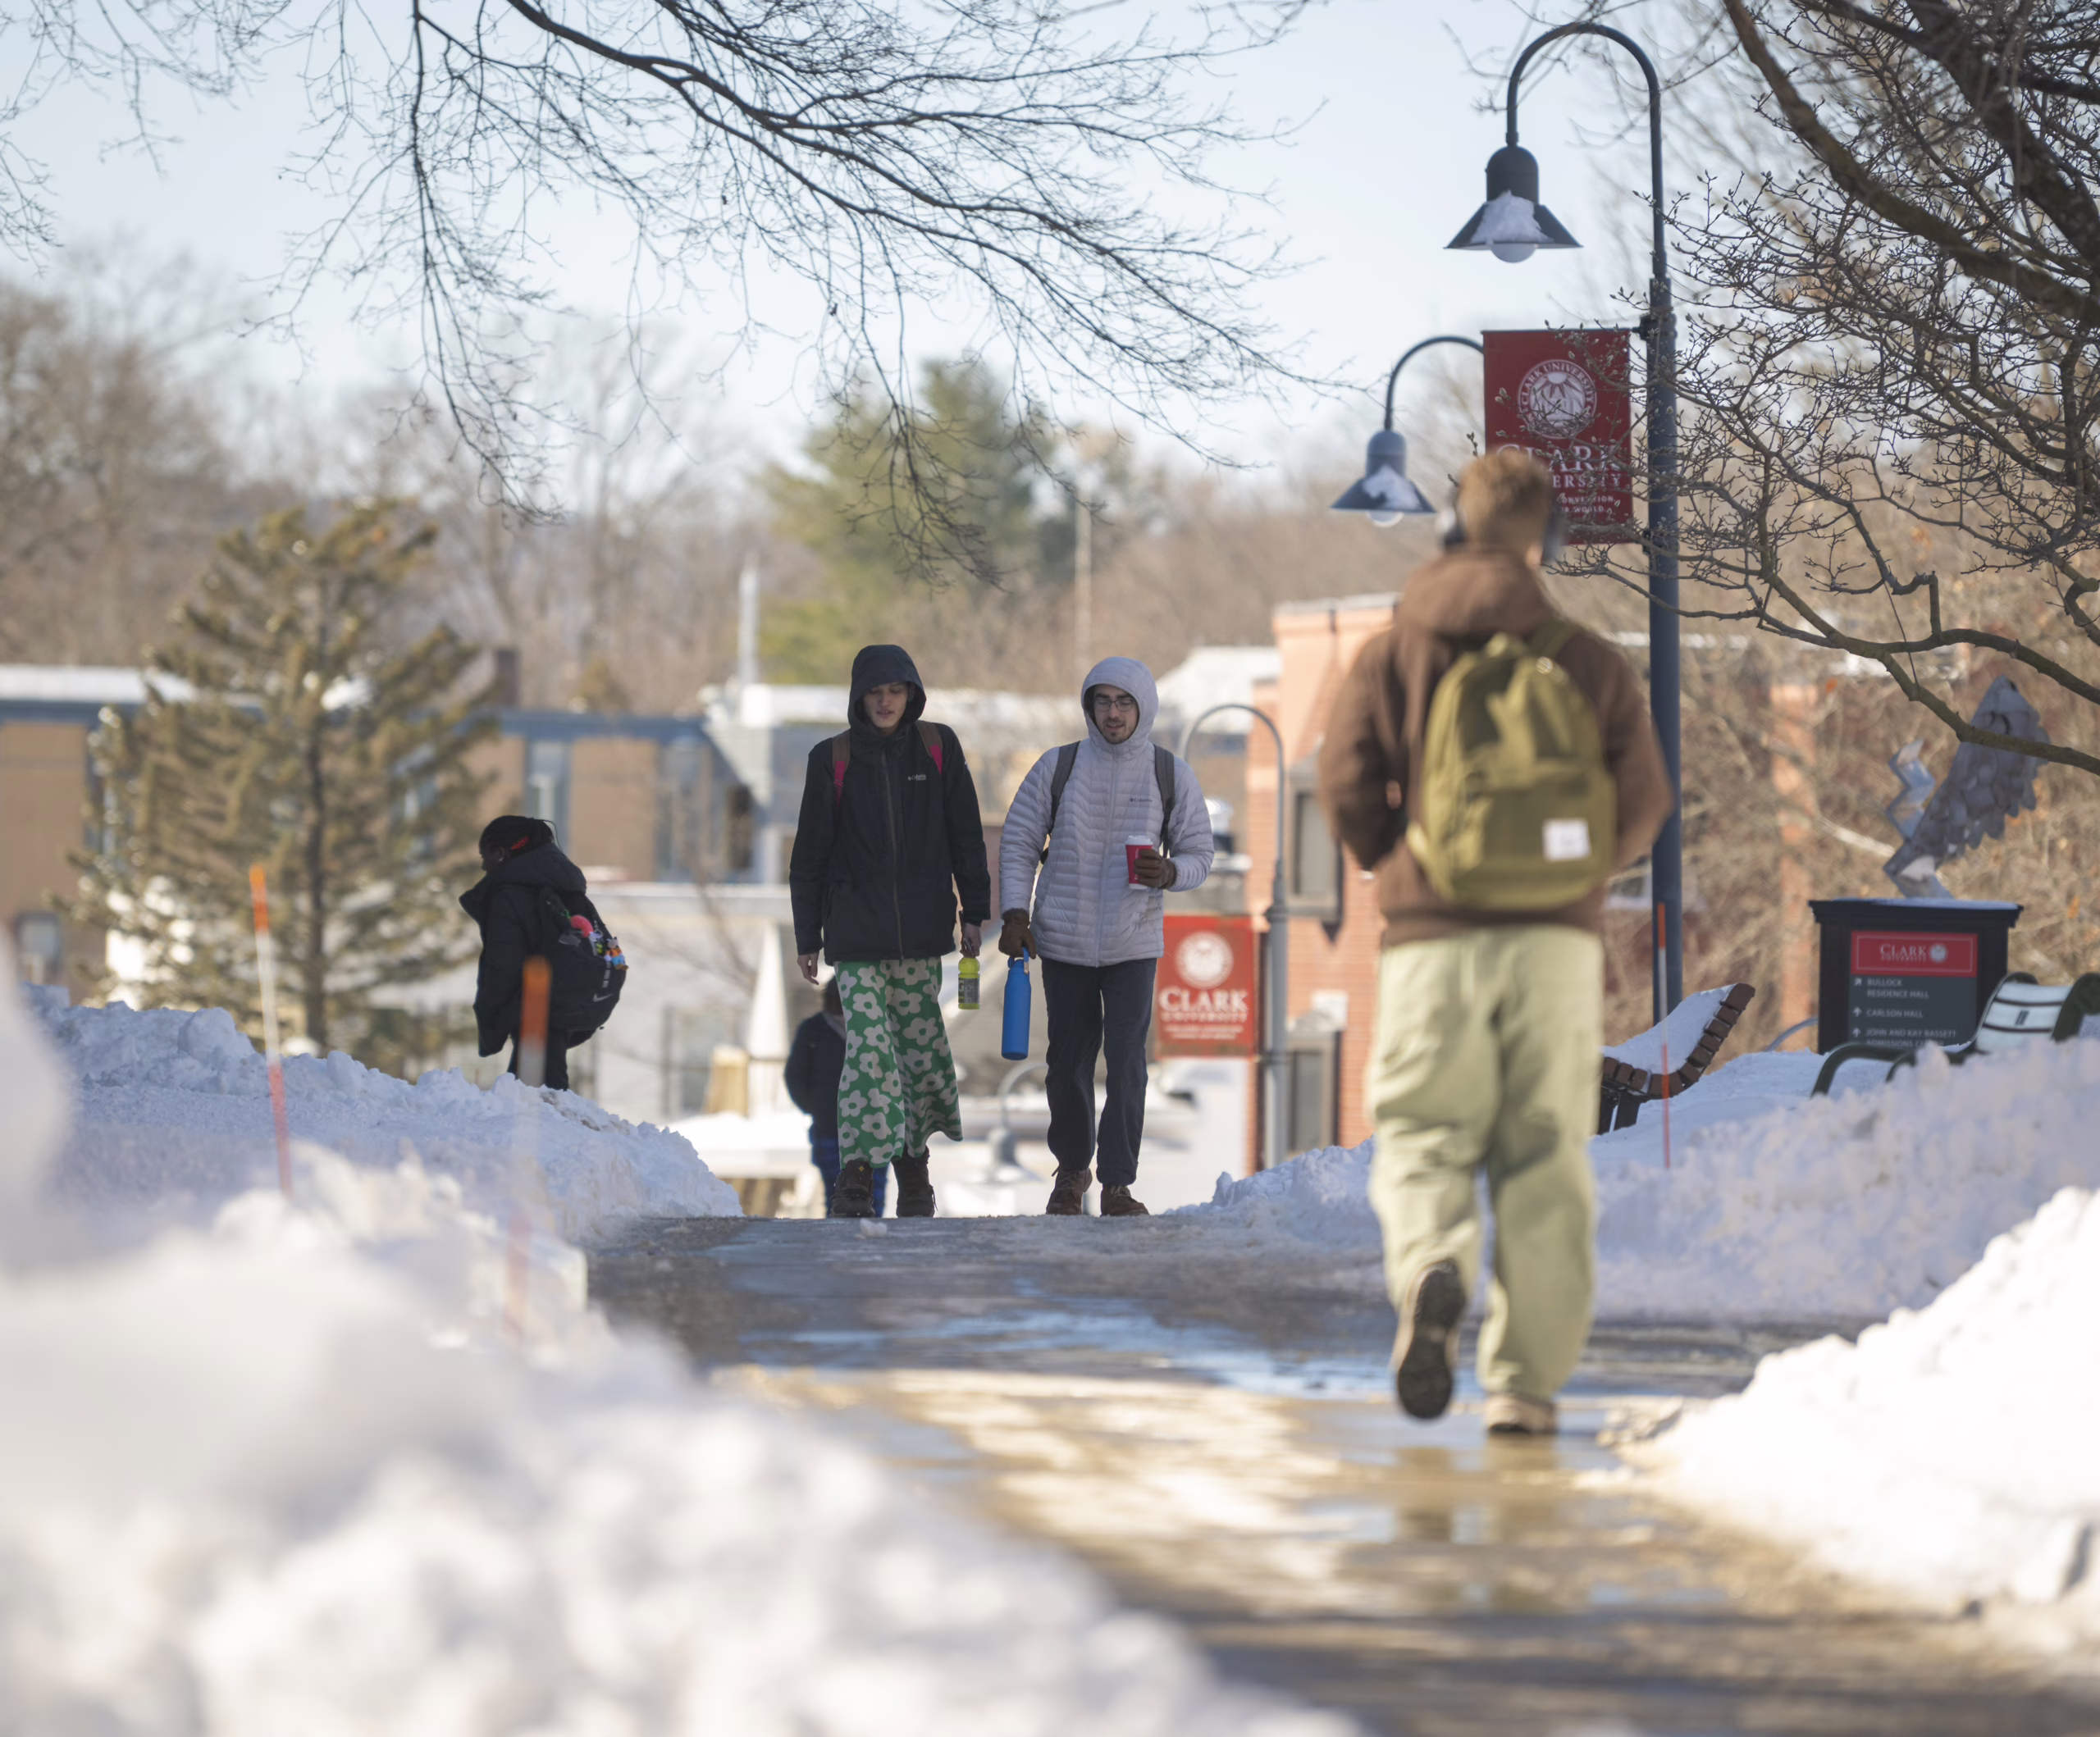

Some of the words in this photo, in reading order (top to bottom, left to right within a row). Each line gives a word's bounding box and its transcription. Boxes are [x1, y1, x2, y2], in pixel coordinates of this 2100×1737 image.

[1522, 368, 1543, 405] CLARK
[1543, 362, 1595, 403] UNIVERSITY
[1879, 944, 1927, 957] CLARK
[1867, 978, 1902, 987] BULLOCK
[1158, 986, 1249, 1012] CLARK
[1867, 989, 1908, 998] RESIDENCE
[1910, 991, 1929, 999] HALL
[1866, 1009, 1902, 1018] CARLSON
[1904, 1010, 1923, 1019] HALL
[1866, 1028, 1888, 1037] JOHN
[1889, 1028, 1906, 1037] AND
[1907, 1029, 1923, 1037] KAY
